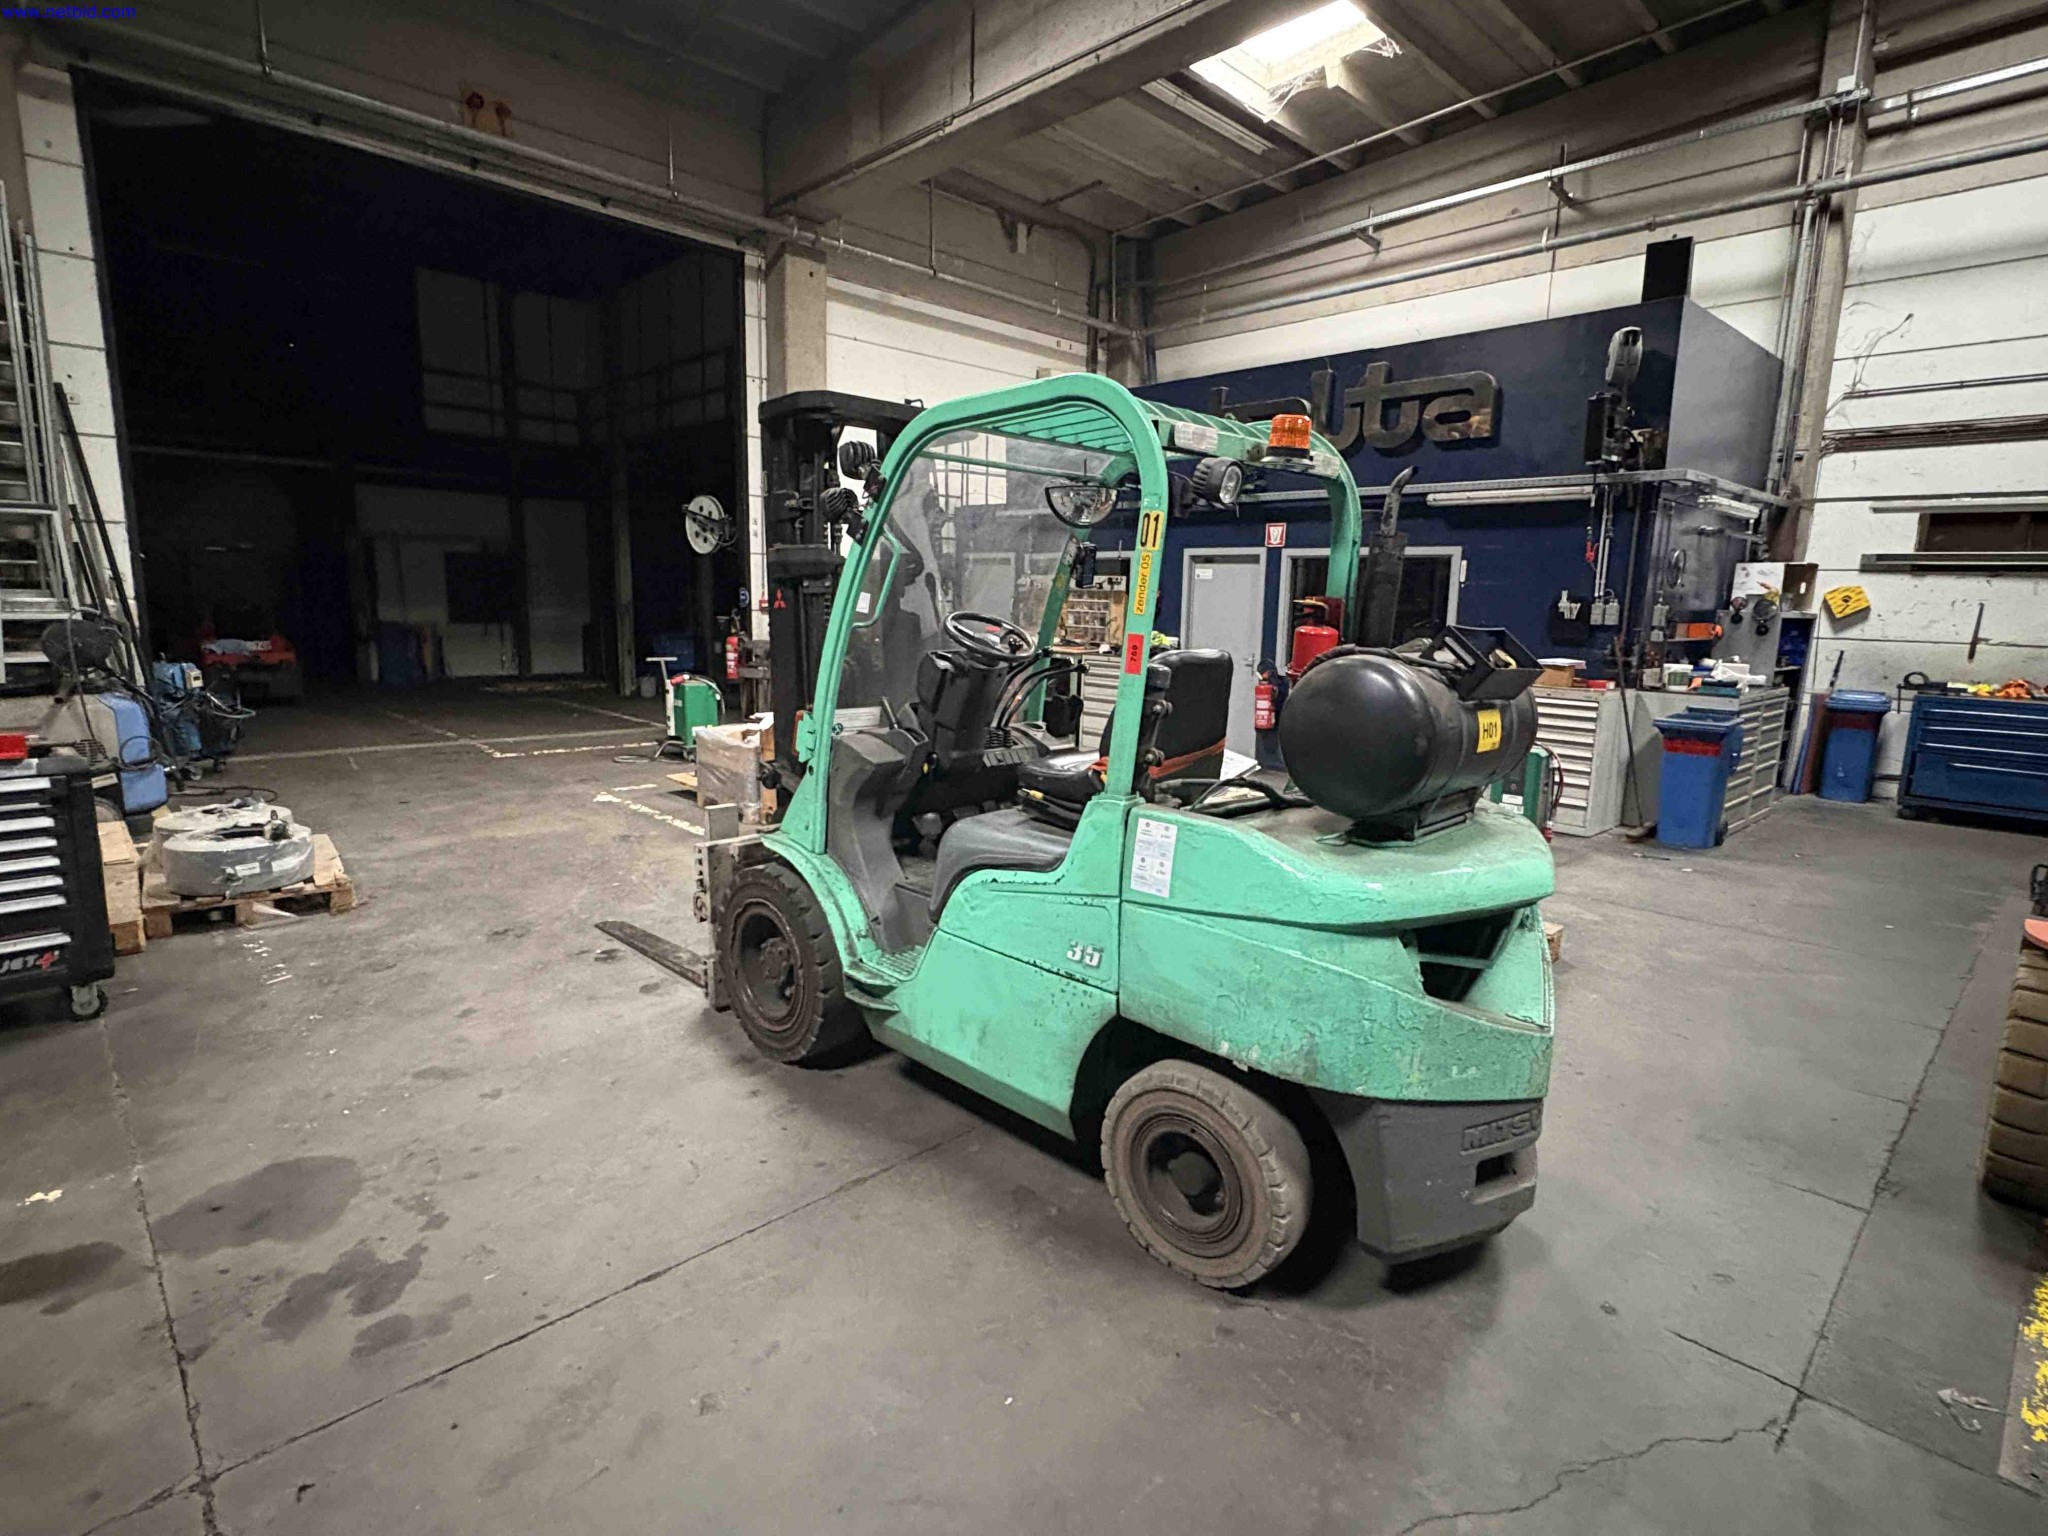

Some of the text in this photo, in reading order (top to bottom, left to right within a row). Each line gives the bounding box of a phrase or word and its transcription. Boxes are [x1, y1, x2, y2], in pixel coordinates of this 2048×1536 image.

[1140, 513, 1160, 547] 01
[1136, 554, 1150, 614] zender 05
[1066, 939, 1103, 968] 35
